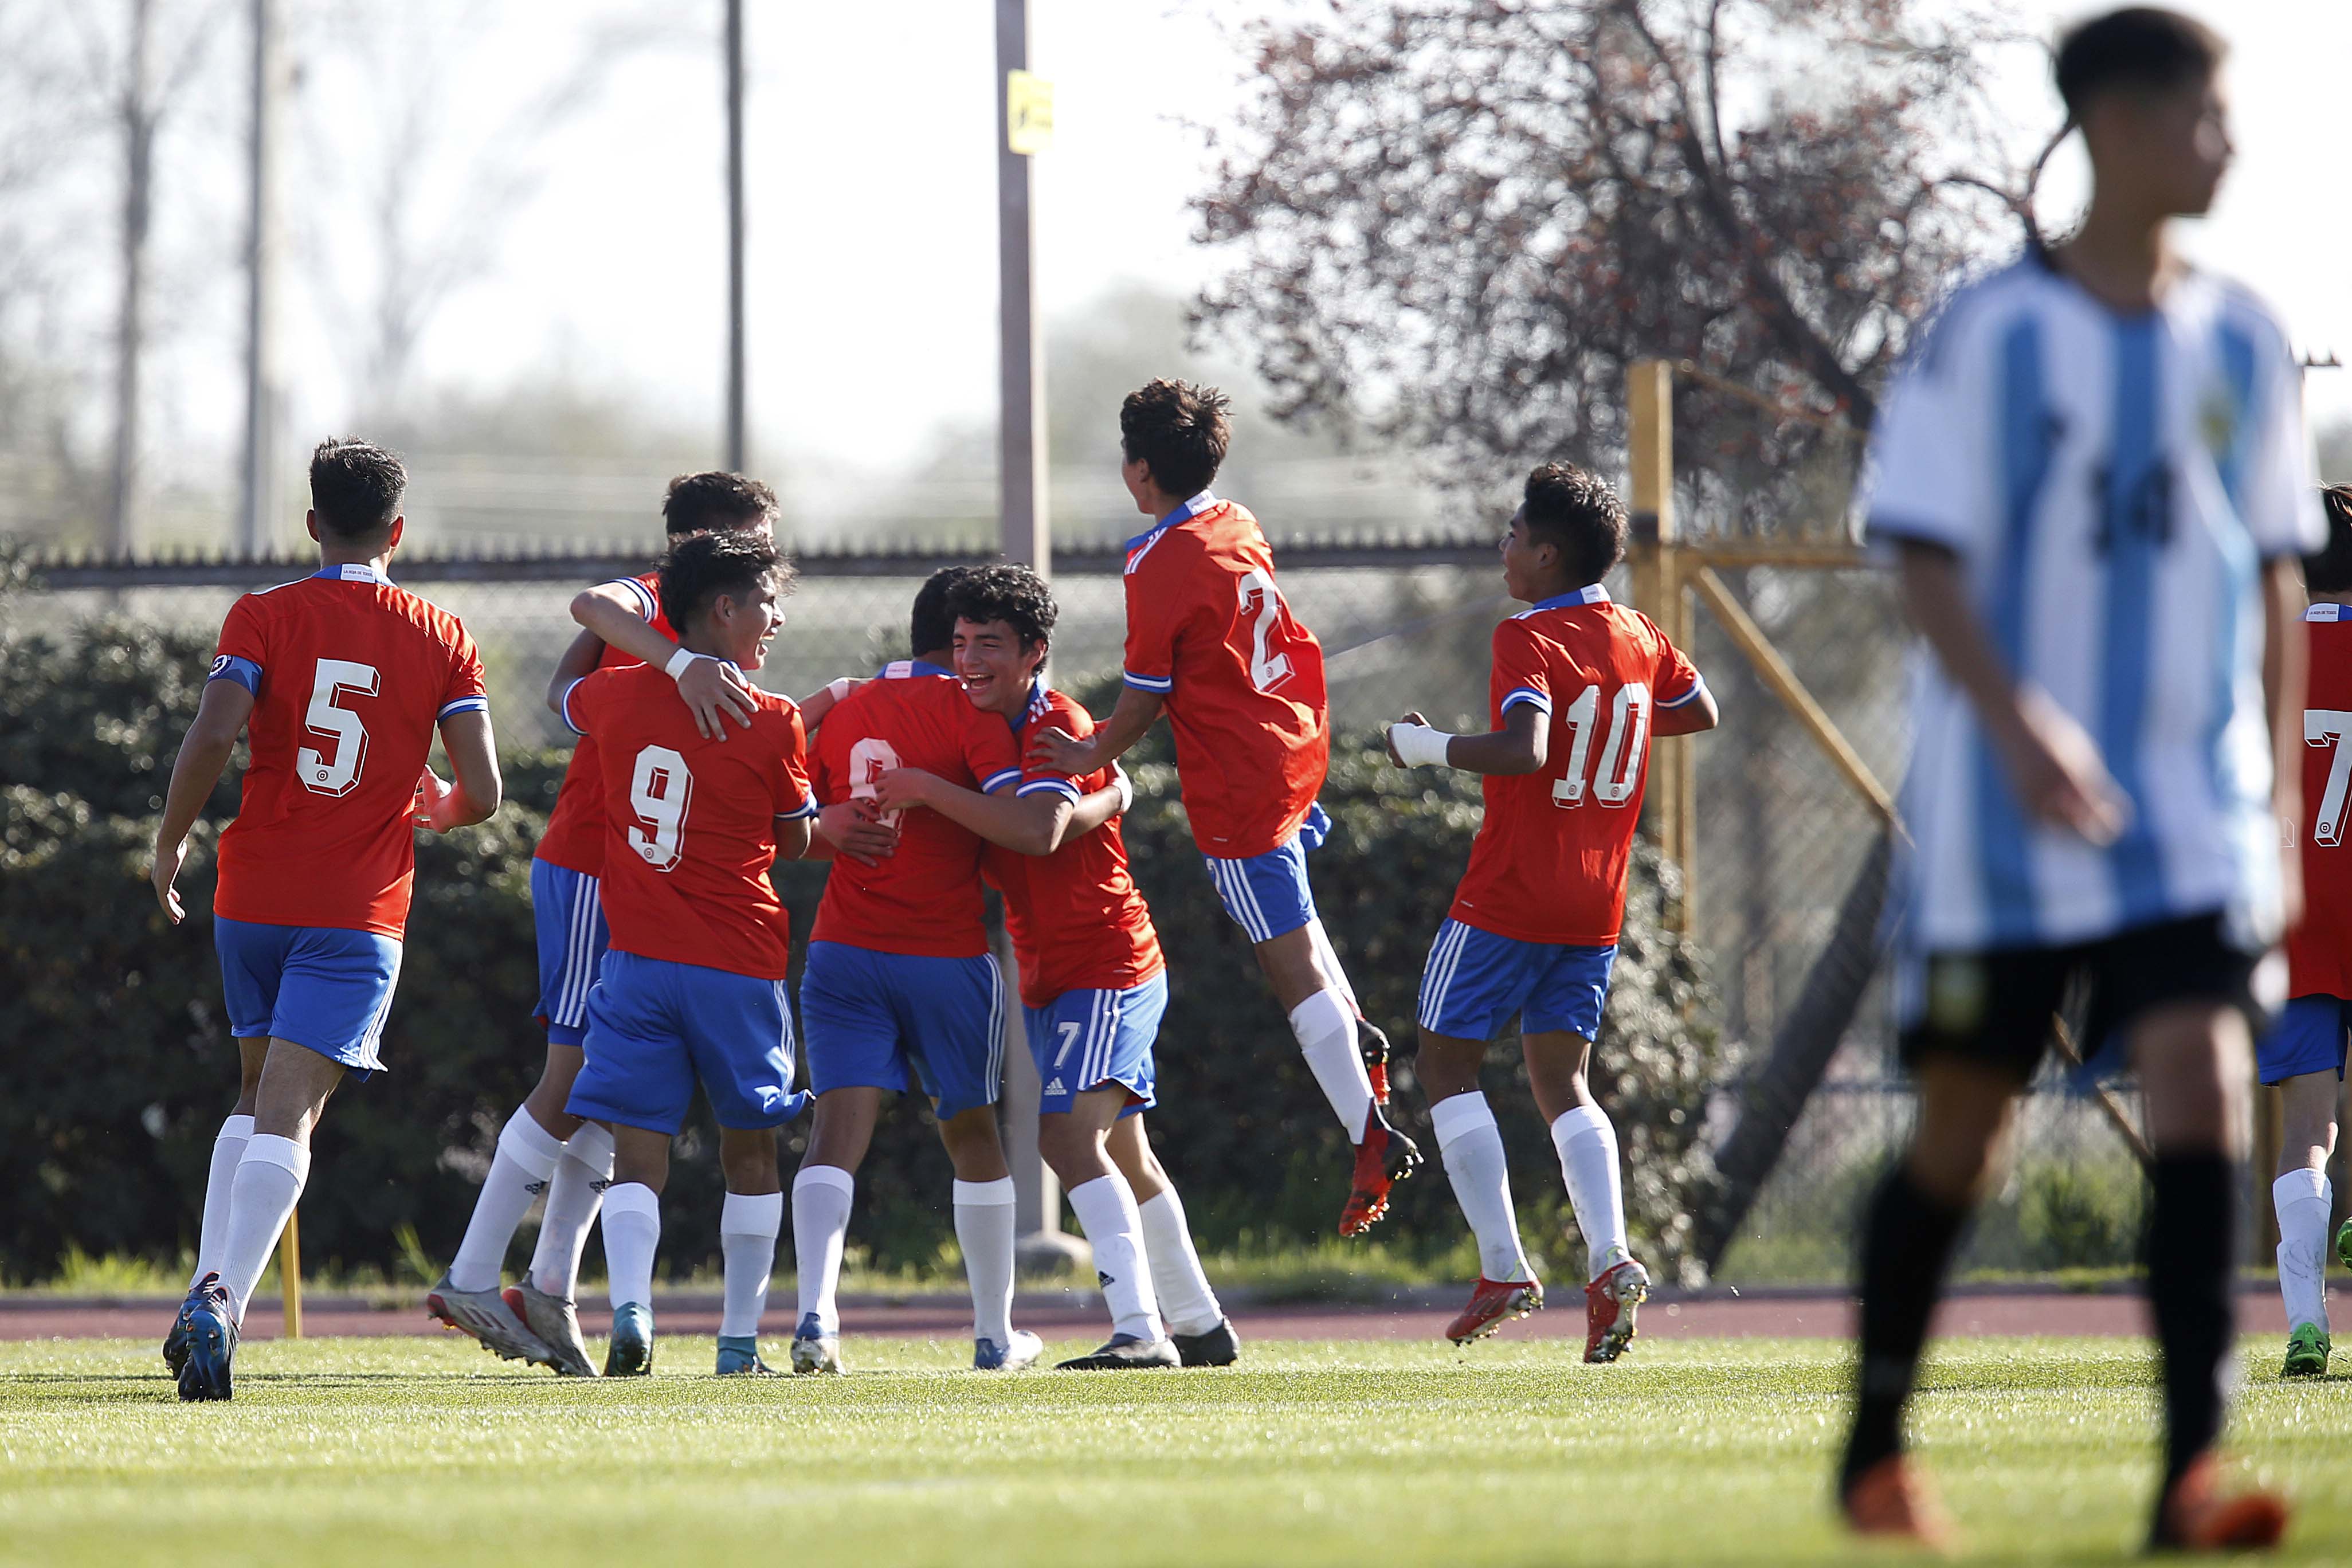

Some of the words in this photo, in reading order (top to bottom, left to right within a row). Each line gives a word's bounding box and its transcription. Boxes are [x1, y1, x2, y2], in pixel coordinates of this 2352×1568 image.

[1238, 566, 1295, 694] 2
[296, 658, 381, 797] 5
[1551, 682, 1649, 809] 10
[628, 744, 693, 872] 9
[1053, 1022, 1080, 1069] 7
